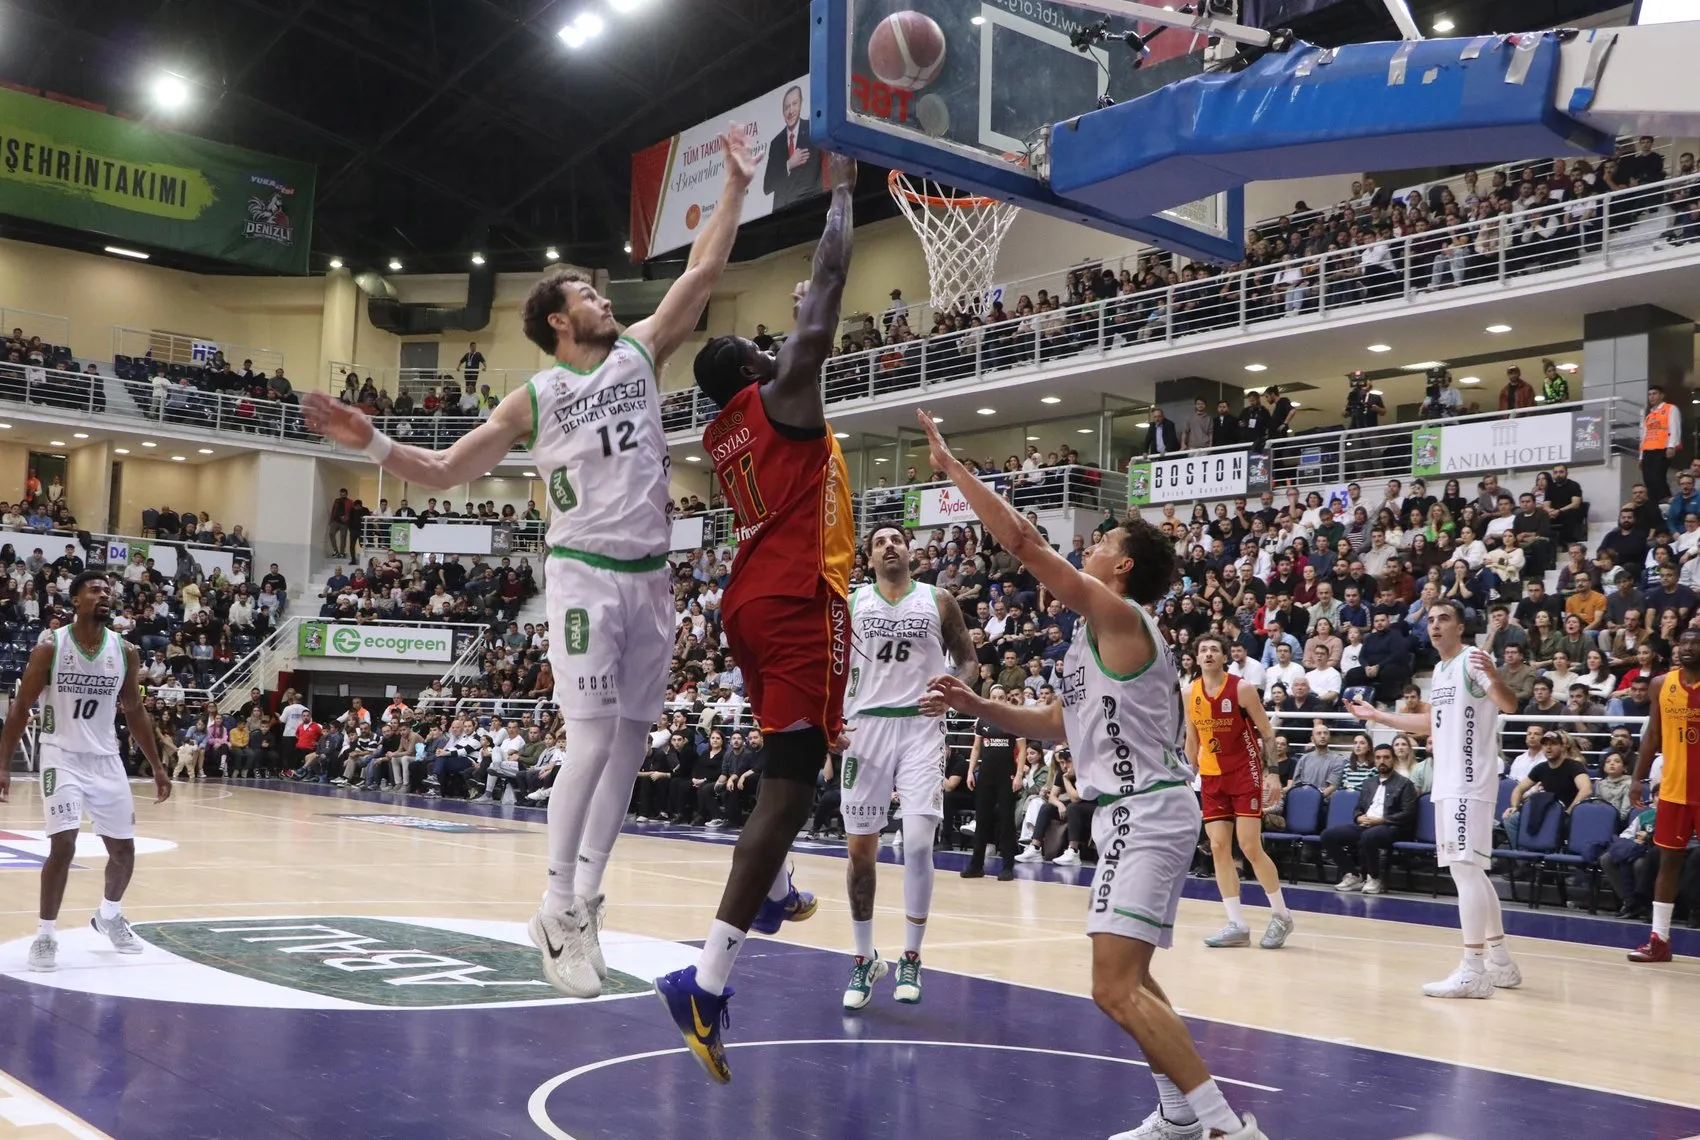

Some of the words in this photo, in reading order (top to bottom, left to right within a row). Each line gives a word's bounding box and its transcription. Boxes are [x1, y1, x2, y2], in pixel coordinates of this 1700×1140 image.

[683, 146, 699, 167] TÜM
[0, 136, 187, 208] ŞEHRİNTAKIMI
[610, 400, 648, 416] BASKET
[597, 420, 638, 458] 12
[1504, 444, 1568, 465] HOTEL
[1155, 457, 1242, 489] BOSTON
[723, 451, 767, 526] 11
[110, 546, 127, 560] D4
[862, 618, 930, 631] YUKAtel
[364, 635, 446, 654] ecogreen
[876, 640, 912, 663] 46
[57, 673, 119, 687] YUKAtel
[72, 699, 100, 720] 10
[1436, 710, 1442, 729] 5
[1208, 737, 1222, 753] 2
[1679, 726, 1699, 745] 10
[1462, 721, 1475, 783] ecogreen
[846, 804, 885, 816] BOSTON
